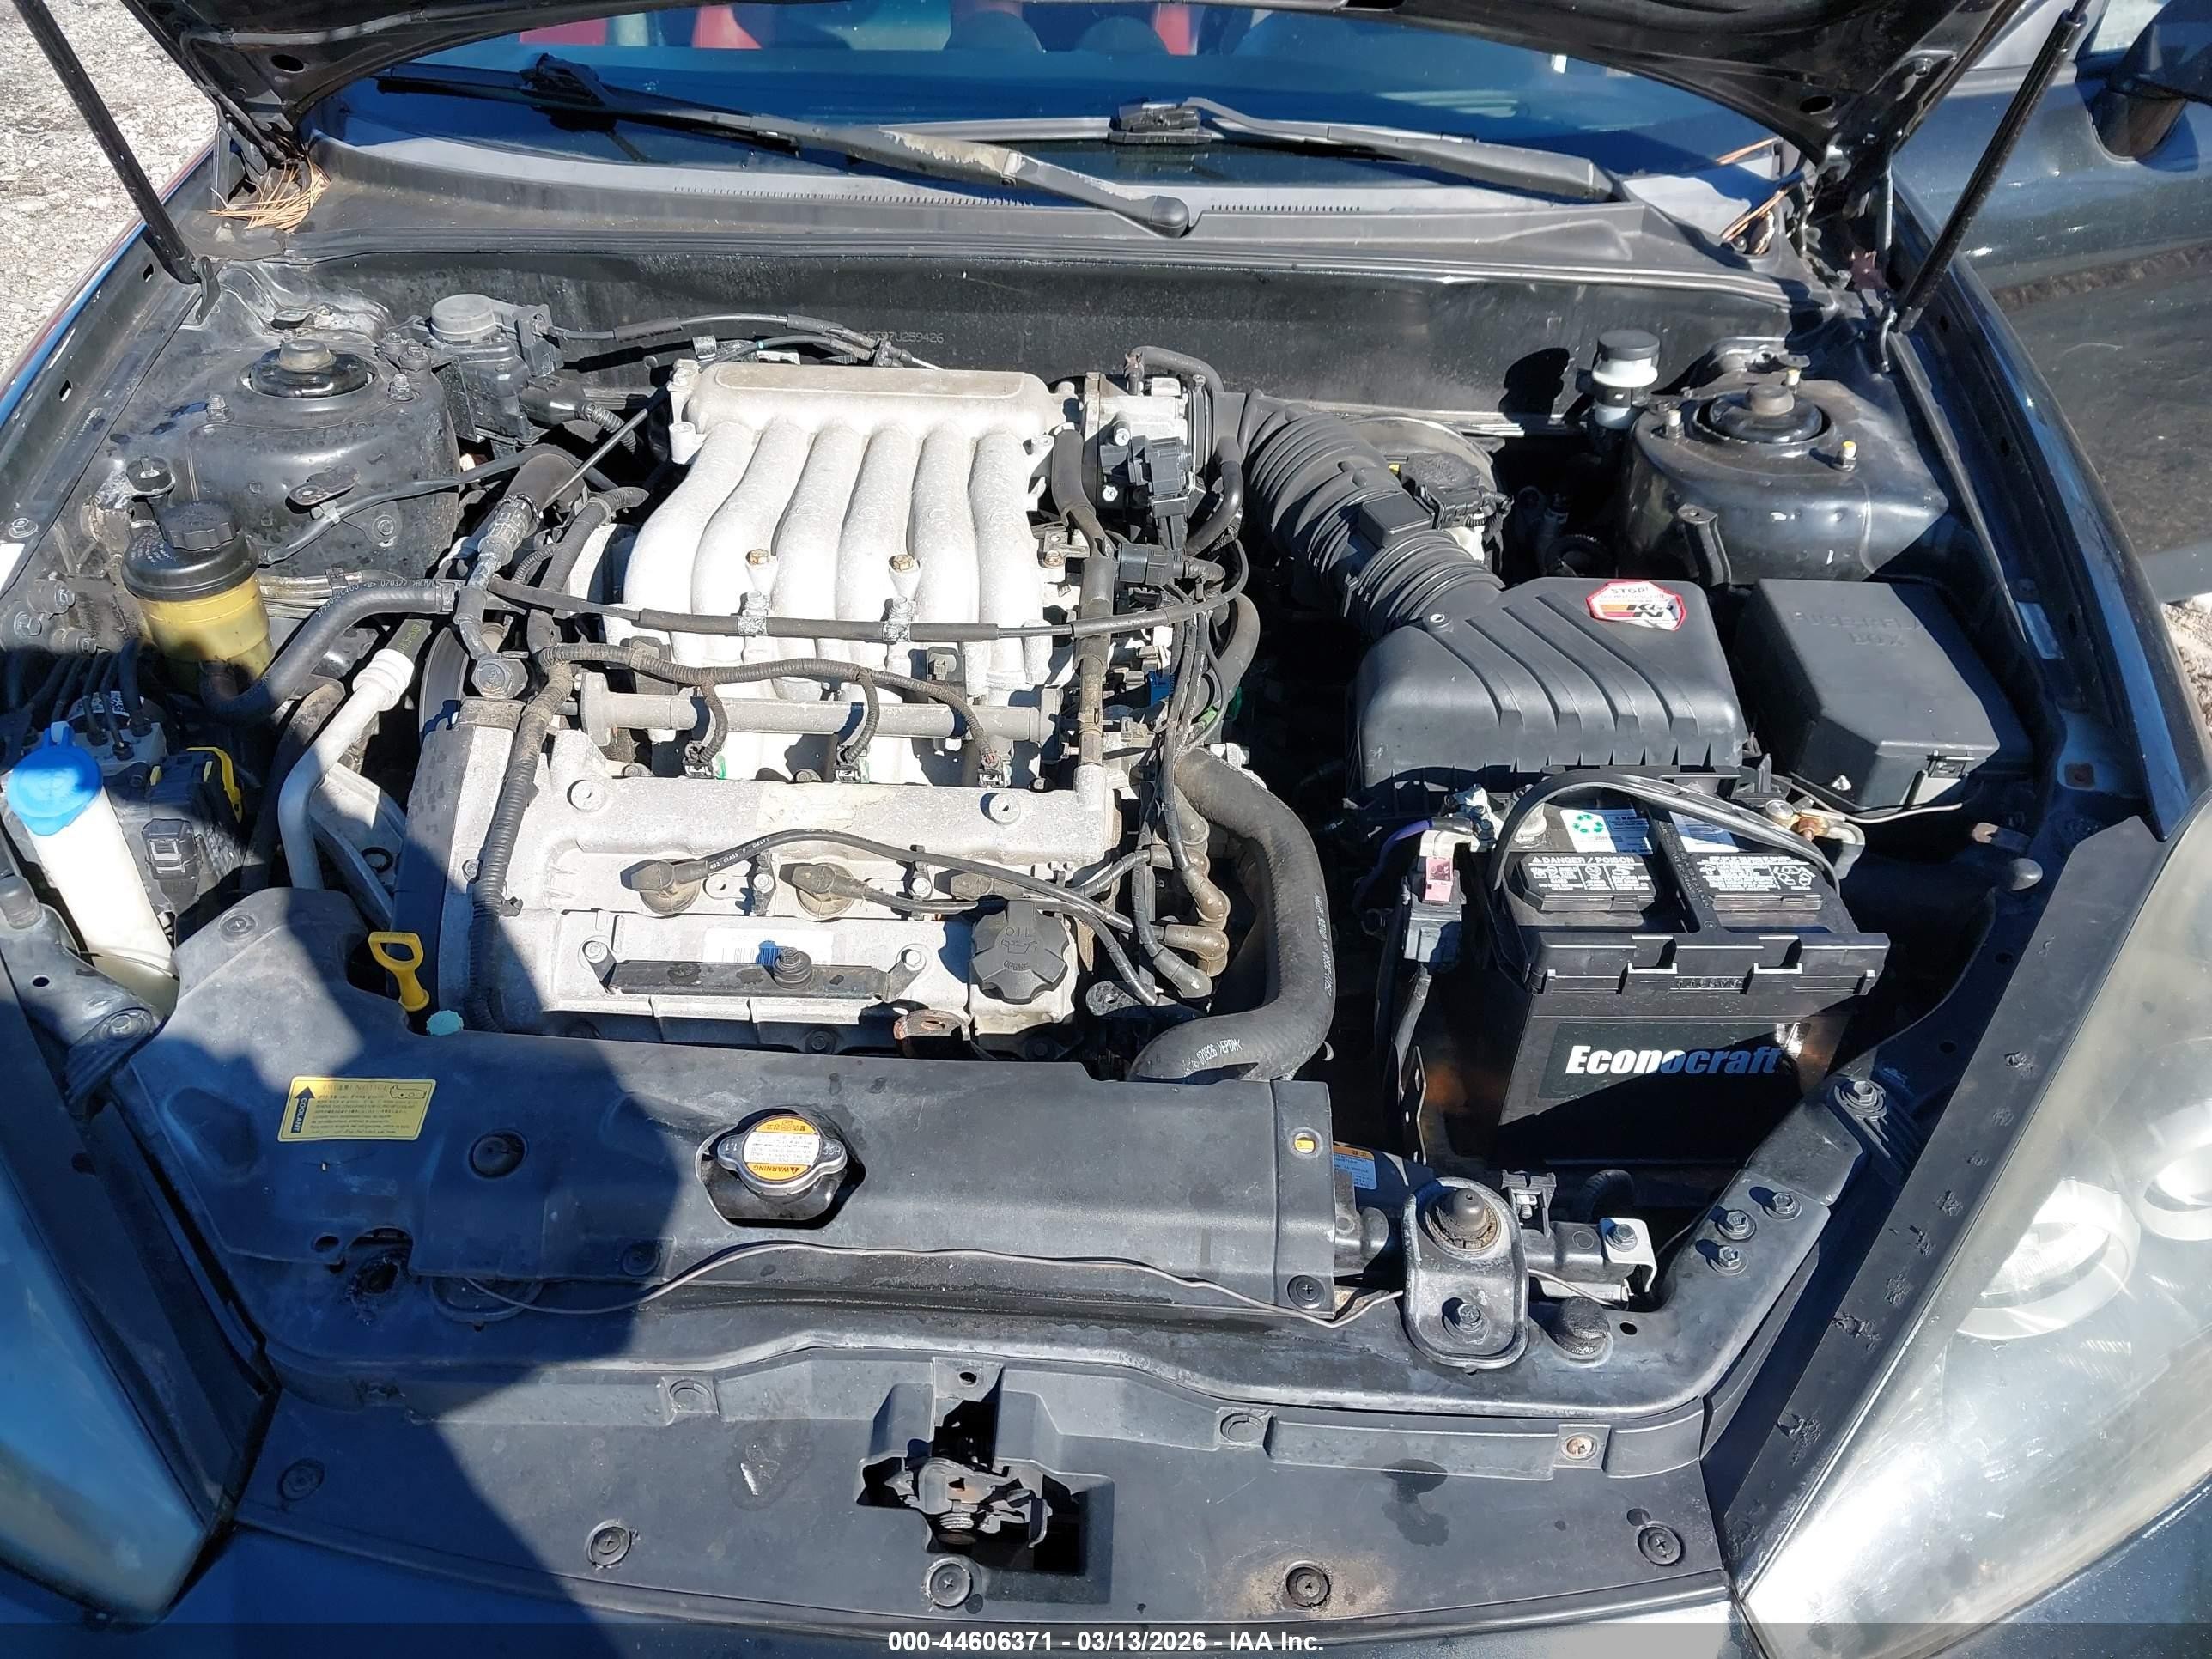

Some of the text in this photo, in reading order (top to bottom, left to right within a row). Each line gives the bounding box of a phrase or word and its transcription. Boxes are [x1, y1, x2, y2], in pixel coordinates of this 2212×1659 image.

[1005, 927, 1031, 938] OIL
[1565, 1044, 1784, 1074] Econocraft
[293, 1097, 308, 1133] COOLANT
[752, 1163, 791, 1174] WARNING
